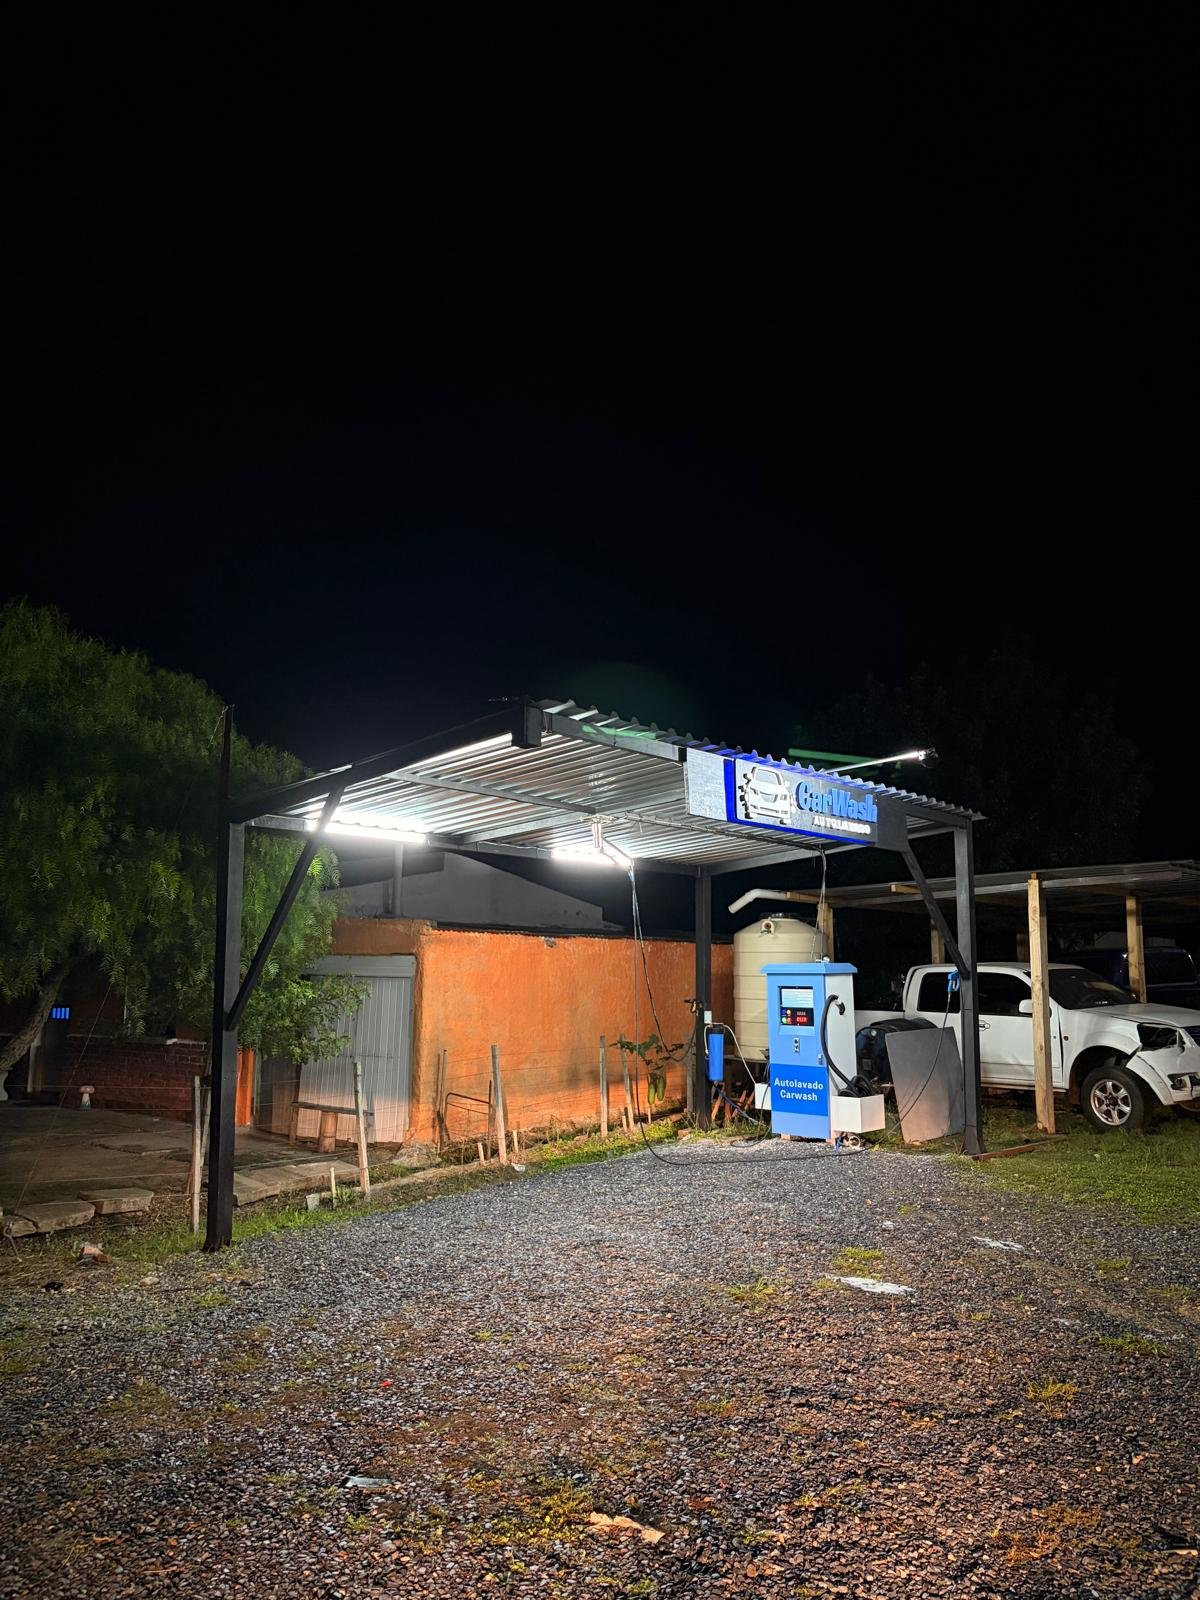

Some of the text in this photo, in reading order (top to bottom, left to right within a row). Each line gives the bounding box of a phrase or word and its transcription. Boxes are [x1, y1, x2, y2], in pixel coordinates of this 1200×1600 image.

[796, 781, 878, 823] CarWash
[774, 1077, 824, 1090] Autolavado
[780, 1089, 818, 1101] Carwash
